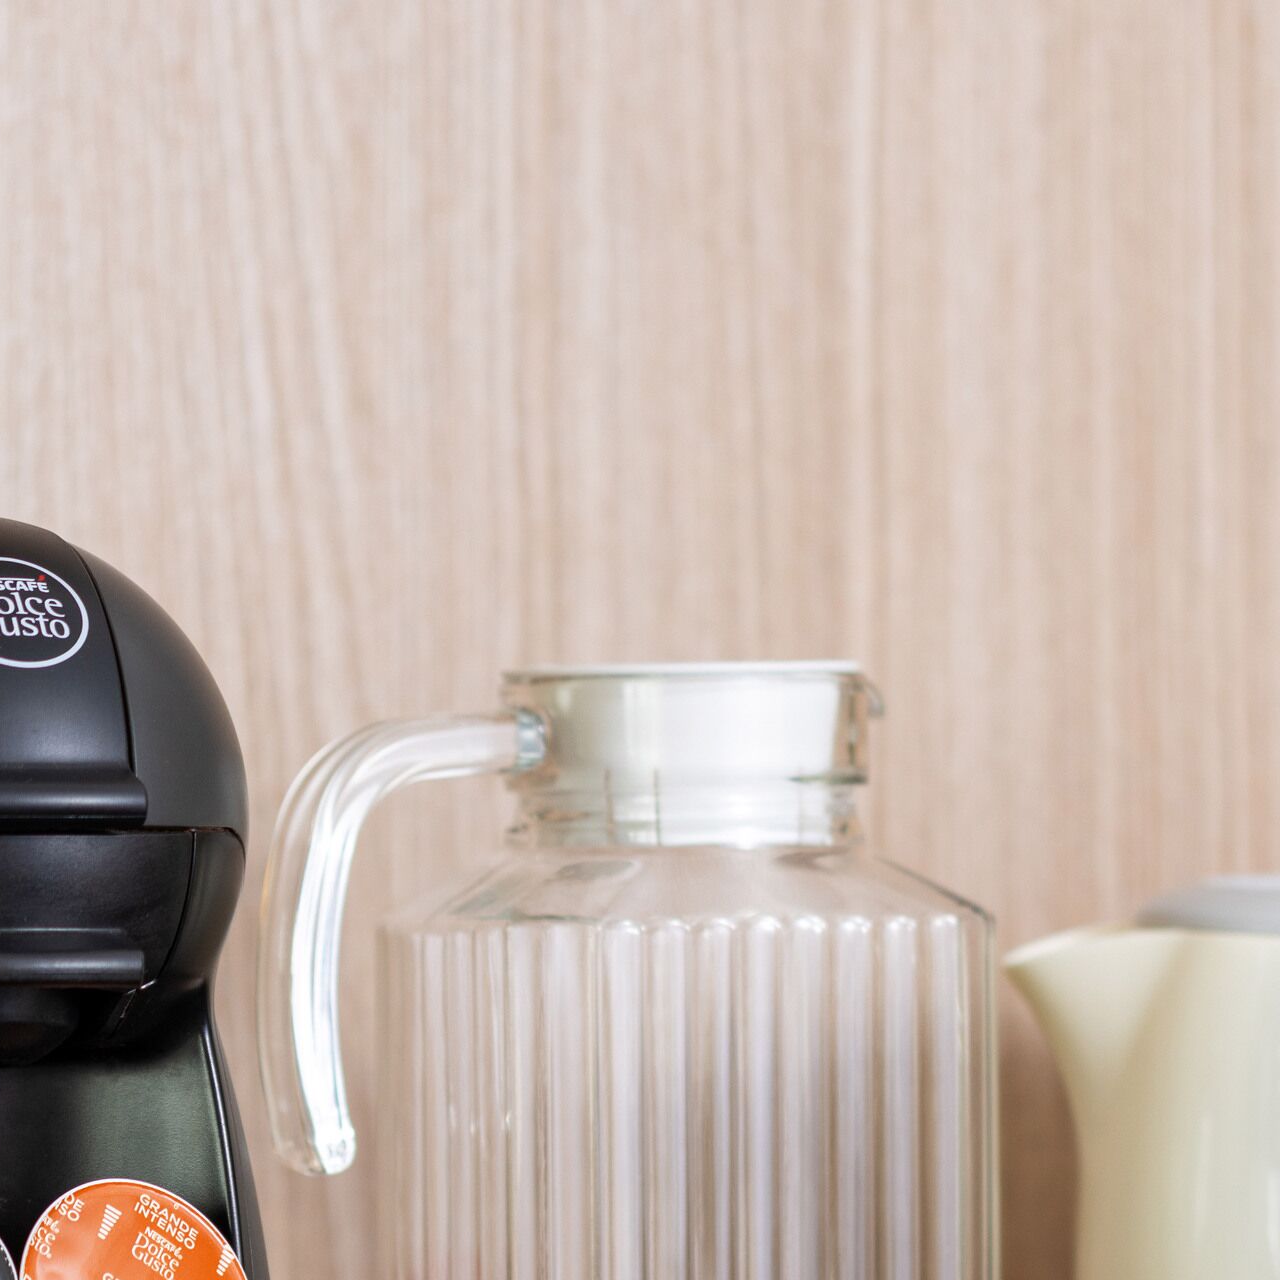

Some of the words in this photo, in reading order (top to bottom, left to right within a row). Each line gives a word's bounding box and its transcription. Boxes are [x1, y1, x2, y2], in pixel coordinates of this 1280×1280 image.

[133, 1201, 195, 1250] INTENSO
[139, 1193, 199, 1241] GRANDE
[134, 1231, 179, 1272] Dolce
